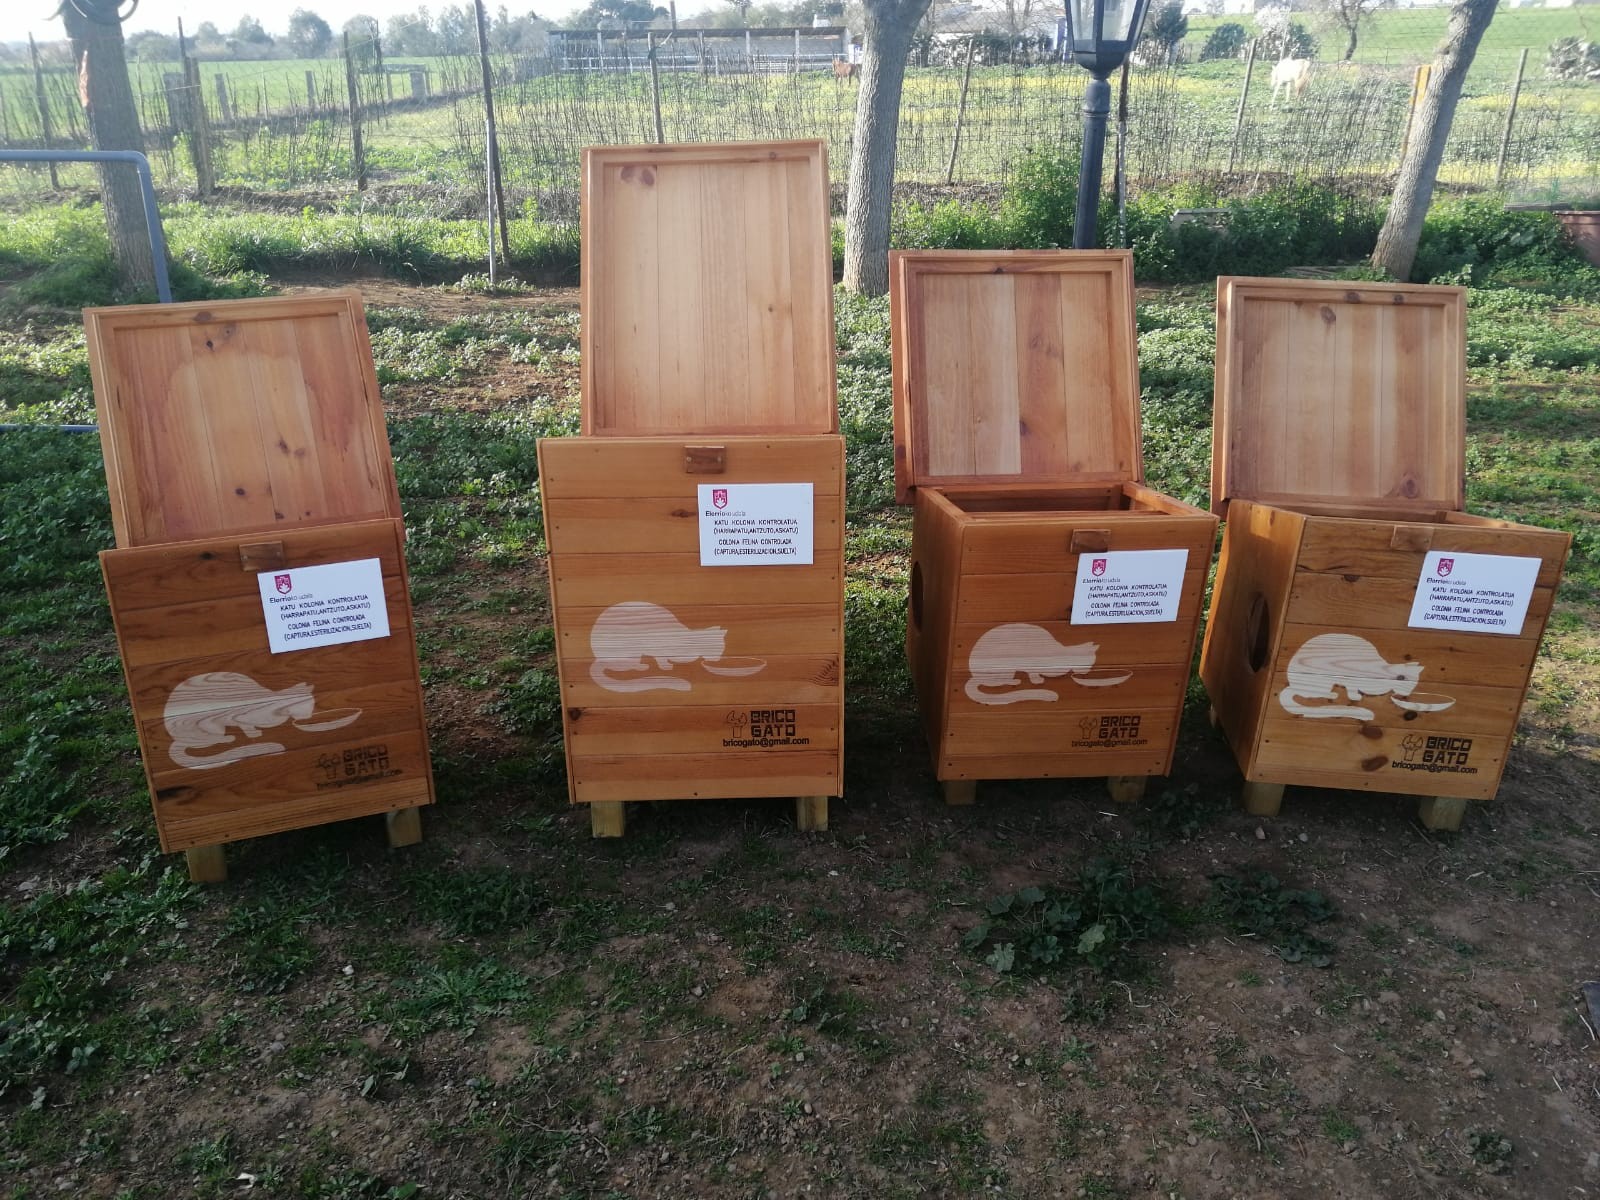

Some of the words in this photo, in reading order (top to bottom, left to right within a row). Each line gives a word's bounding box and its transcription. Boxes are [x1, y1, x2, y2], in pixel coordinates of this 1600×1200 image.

[1476, 590, 1515, 598] KONTROLATUA
[299, 601, 325, 609] KOLONIA
[328, 594, 368, 605] KONTROLATUA
[1431, 604, 1452, 612] COLONIA
[1454, 606, 1470, 614] FELINA
[1472, 608, 1504, 616] CONTROLADA
[288, 621, 311, 630] COLONIA
[332, 614, 366, 624] CONTROLADA
[750, 709, 796, 723] BRICO
[1101, 715, 1141, 727] BRICO
[751, 723, 796, 737] GATO
[1099, 727, 1138, 739] GATO
[722, 737, 810, 748] bricogato@gmail.com
[1425, 736, 1472, 751] BRICO
[343, 744, 388, 762] BRICO
[1422, 750, 1468, 765] GATO
[345, 757, 389, 776] GATO
[1392, 760, 1478, 774] bricogato@gmail.com
